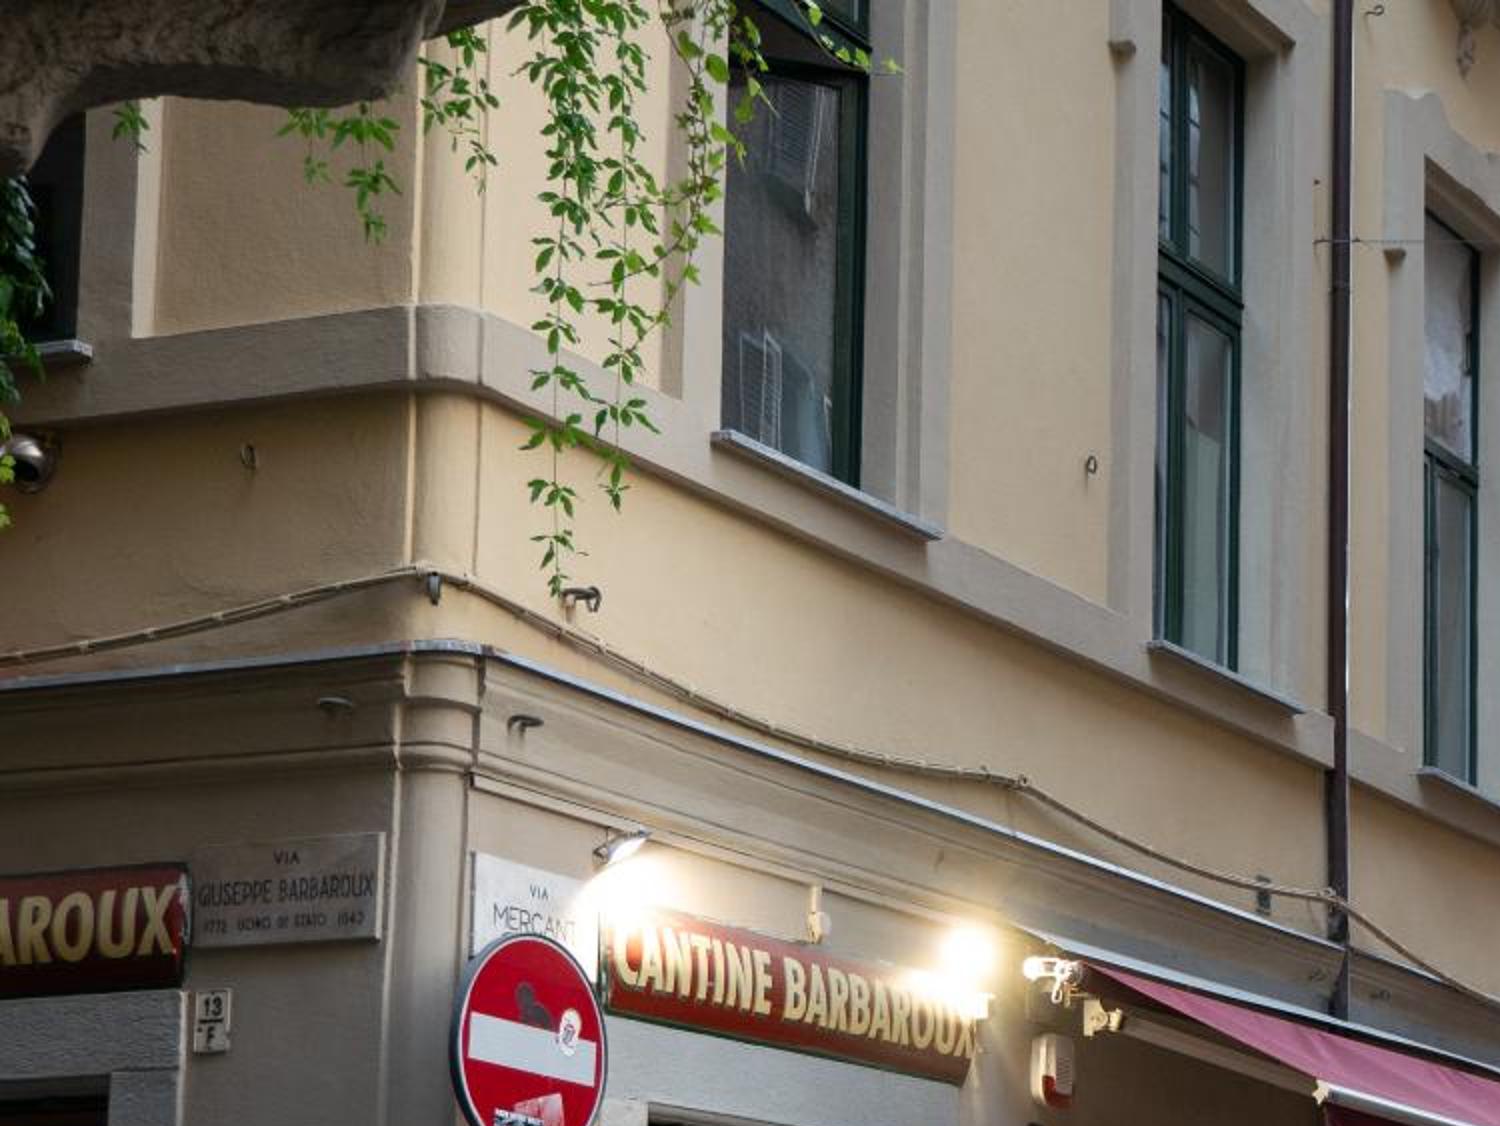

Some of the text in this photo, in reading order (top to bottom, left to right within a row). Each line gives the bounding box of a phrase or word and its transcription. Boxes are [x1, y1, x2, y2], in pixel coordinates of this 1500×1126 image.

[273, 850, 301, 865] VIA
[199, 870, 375, 907] GIUSEPPE BARBAROUX
[530, 884, 549, 900] VIA
[612, 926, 979, 1058] CANTINE BARBAROUX
[203, 997, 223, 1016] 13
